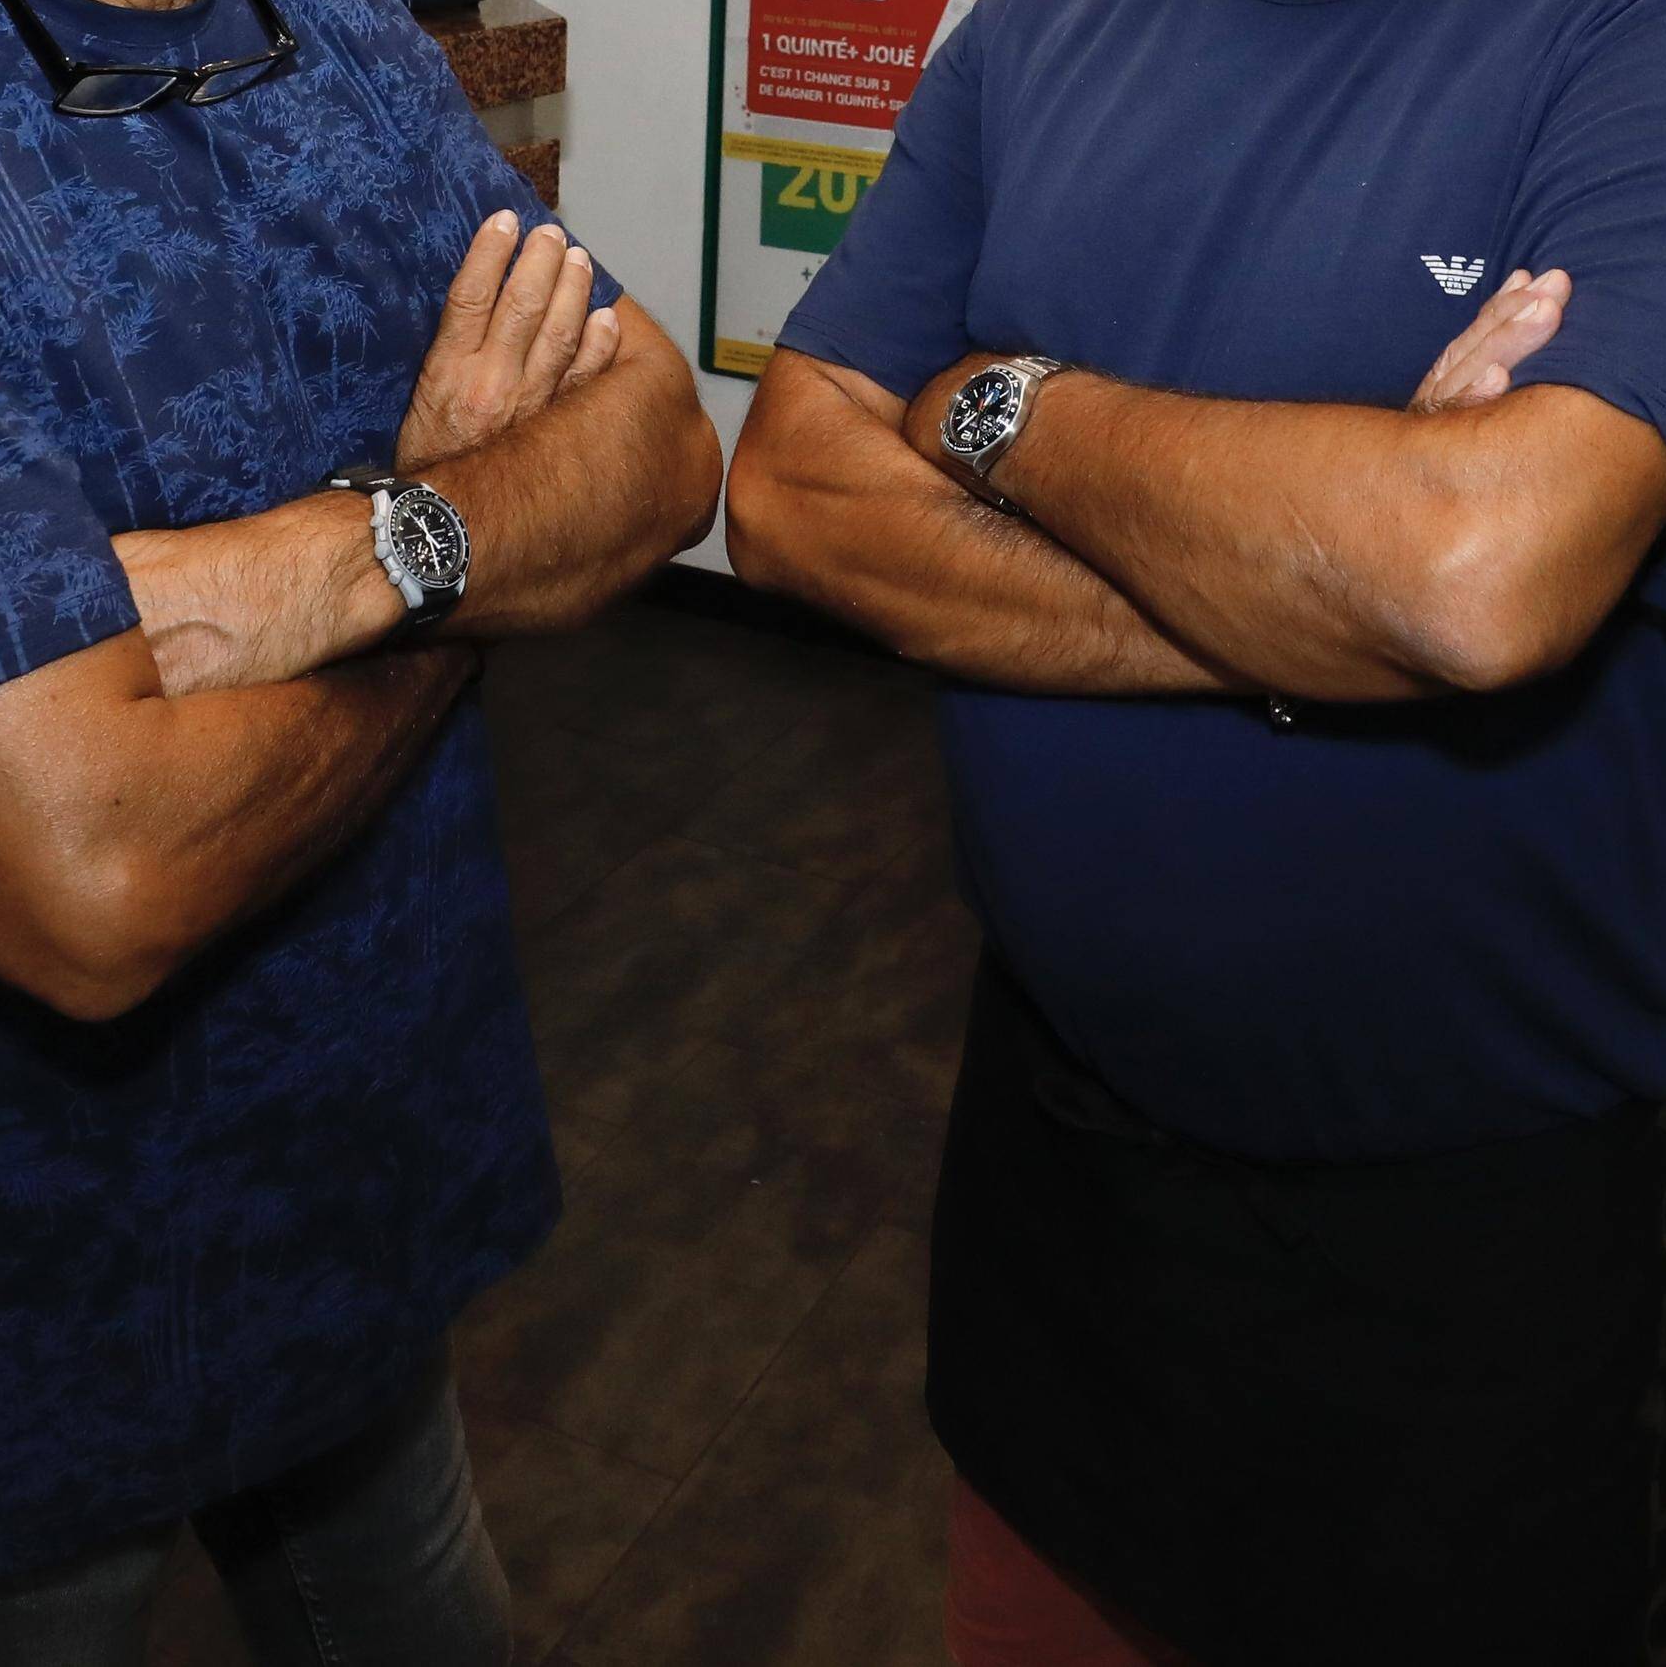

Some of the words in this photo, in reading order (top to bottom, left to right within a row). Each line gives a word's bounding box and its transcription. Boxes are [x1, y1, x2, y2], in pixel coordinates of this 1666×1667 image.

[762, 33, 770, 51] 1
[776, 37, 859, 60] QUINTÉ+
[863, 45, 916, 68] JOUÉ
[759, 65, 792, 78] C'EST
[795, 69, 800, 80] 1
[803, 70, 853, 87] CHANCE
[854, 75, 879, 90] SUR
[882, 79, 891, 92] 3
[759, 84, 774, 96] DE
[776, 86, 824, 102] GAGNER
[827, 91, 833, 102] 1
[835, 91, 887, 110] QUINTÉ+
